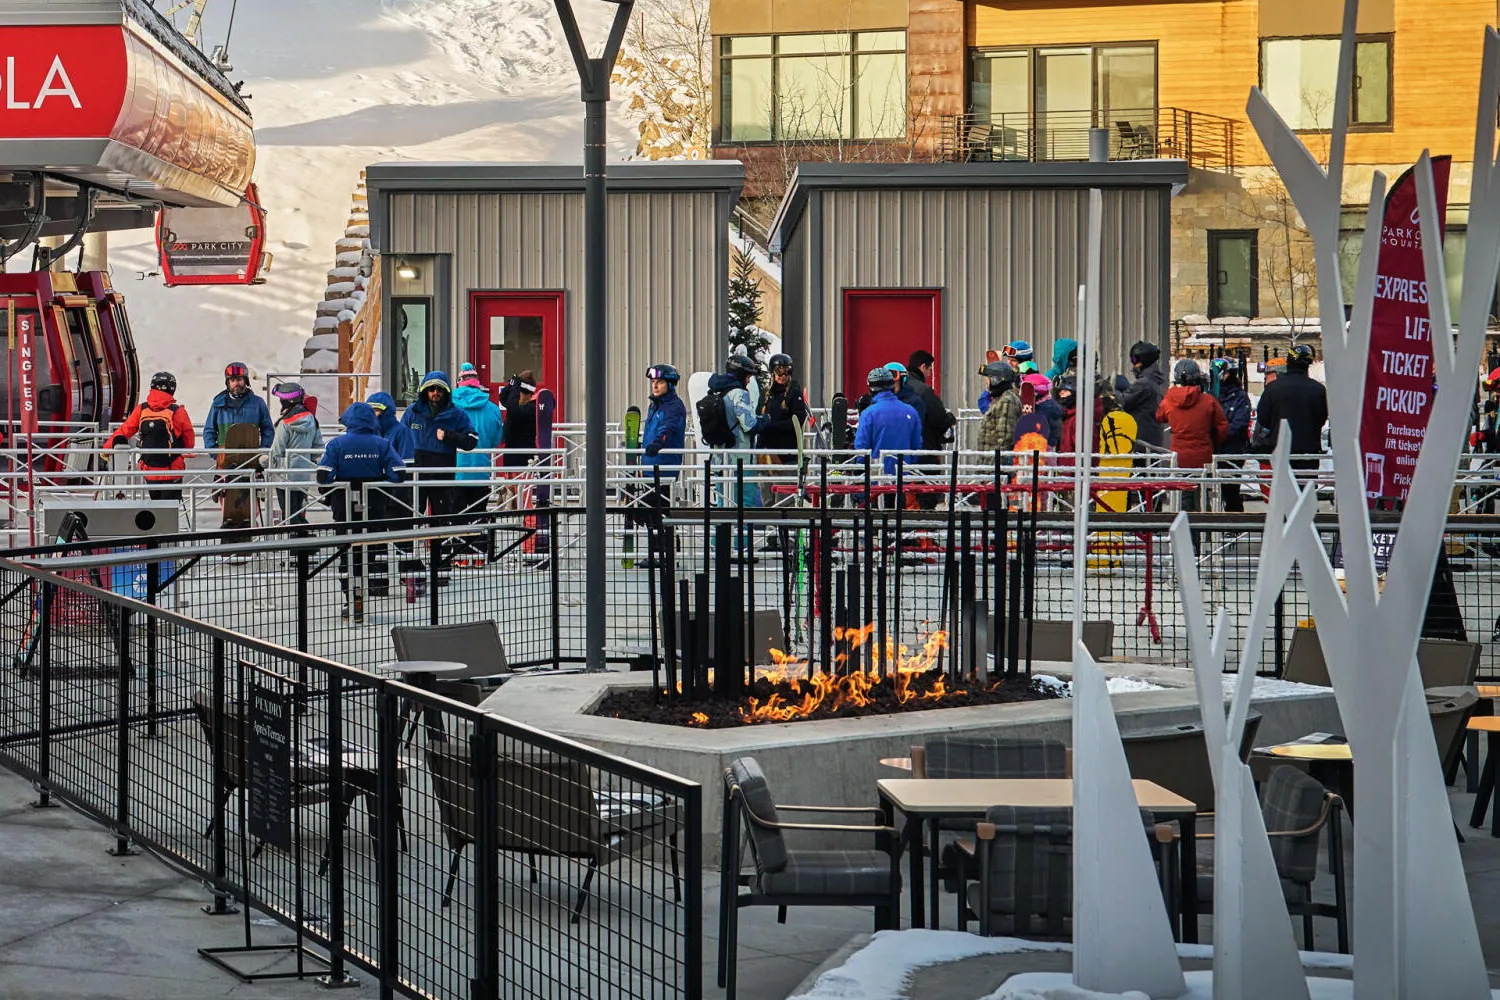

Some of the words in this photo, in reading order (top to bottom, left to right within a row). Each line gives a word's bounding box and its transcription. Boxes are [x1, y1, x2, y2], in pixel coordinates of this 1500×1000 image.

[220, 242, 243, 250] CITY
[1374, 274, 1428, 304] EXPRES
[21, 320, 33, 411] SINGLES
[1381, 350, 1429, 378] TICKET
[1376, 386, 1427, 415] PICKUP
[1387, 423, 1426, 438] Purchased
[1385, 438, 1397, 450] lift
[1396, 455, 1417, 466] onlin
[255, 695, 283, 719] PENDRY
